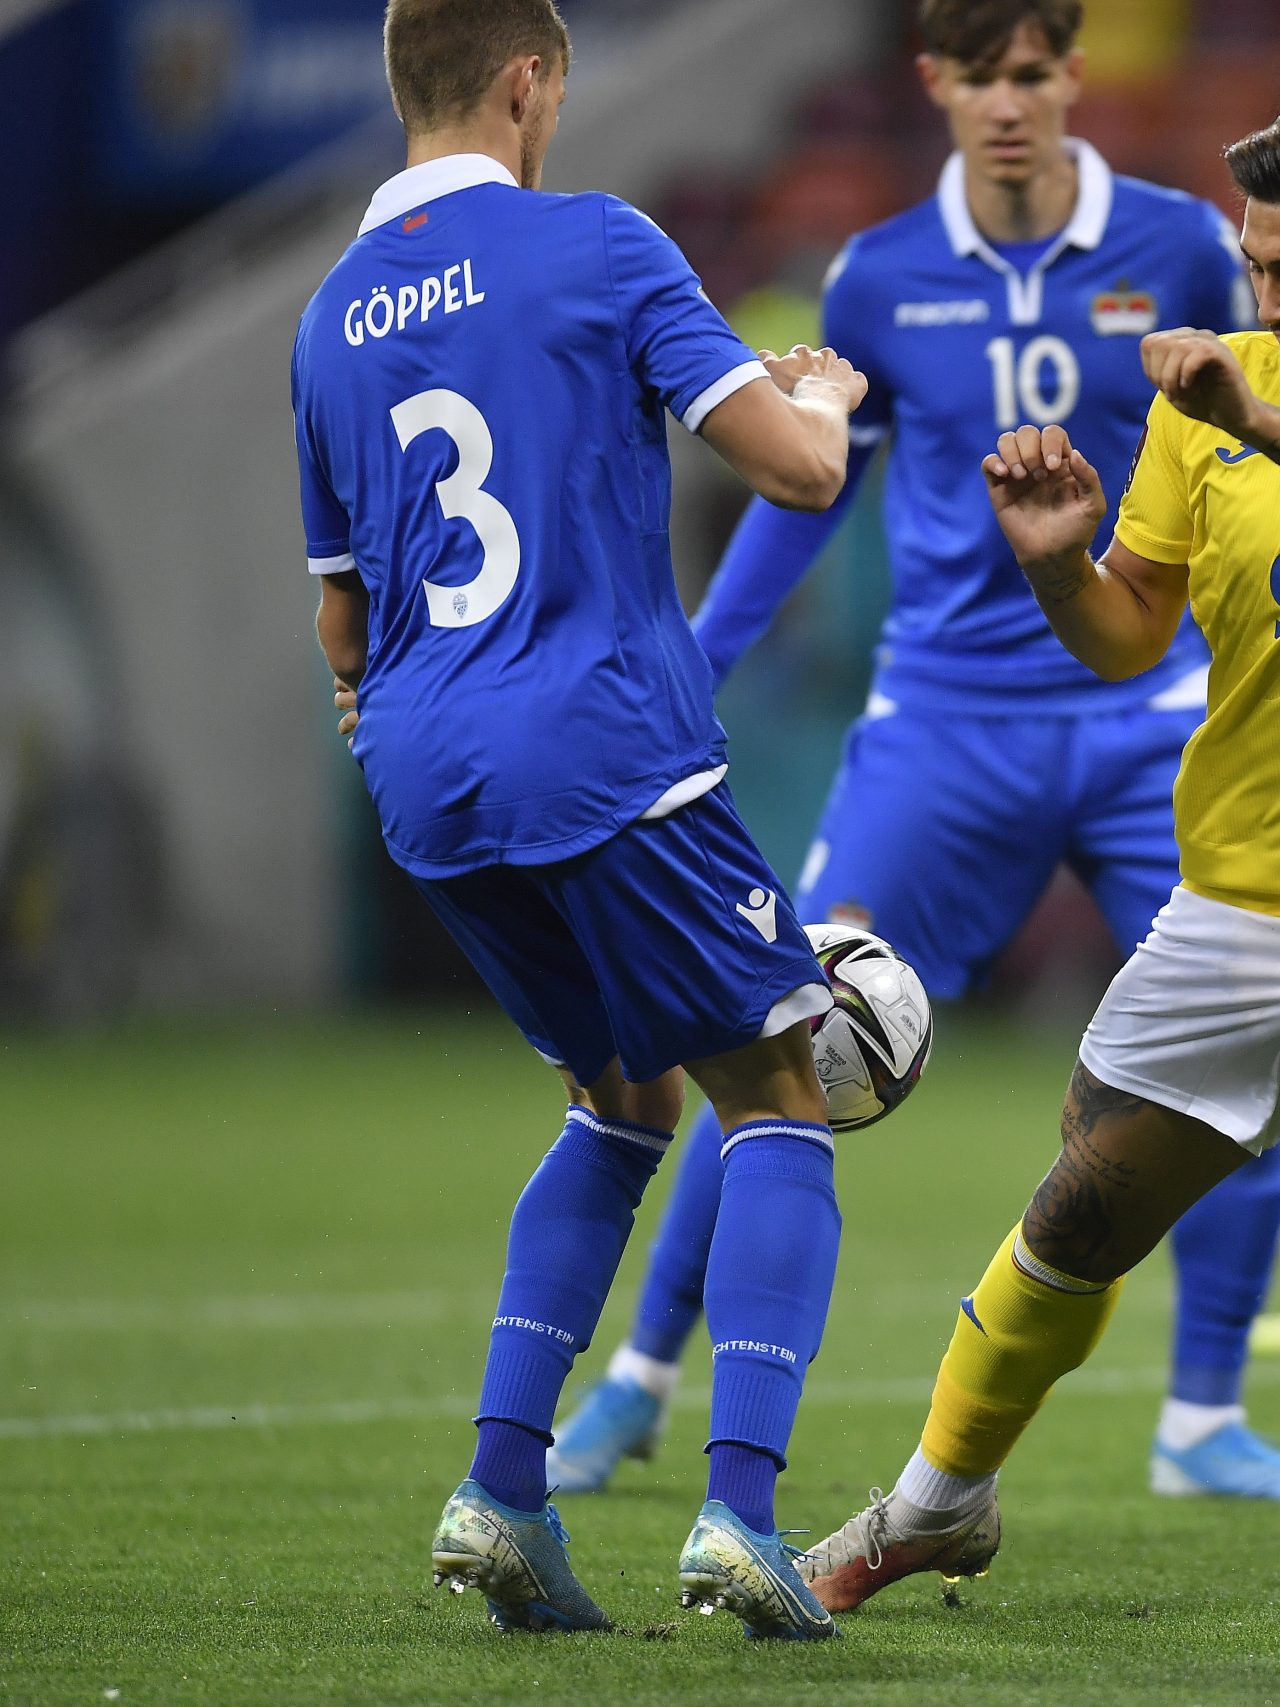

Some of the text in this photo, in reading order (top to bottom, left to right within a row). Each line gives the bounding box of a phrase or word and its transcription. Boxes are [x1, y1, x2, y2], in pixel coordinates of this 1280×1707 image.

[344, 258, 486, 346] GÖPPEL
[986, 335, 1081, 428] 10
[389, 388, 521, 628] 3
[492, 1316, 574, 1345] CHTENSTEIN
[712, 1340, 797, 1363] CHTENSTEIN
